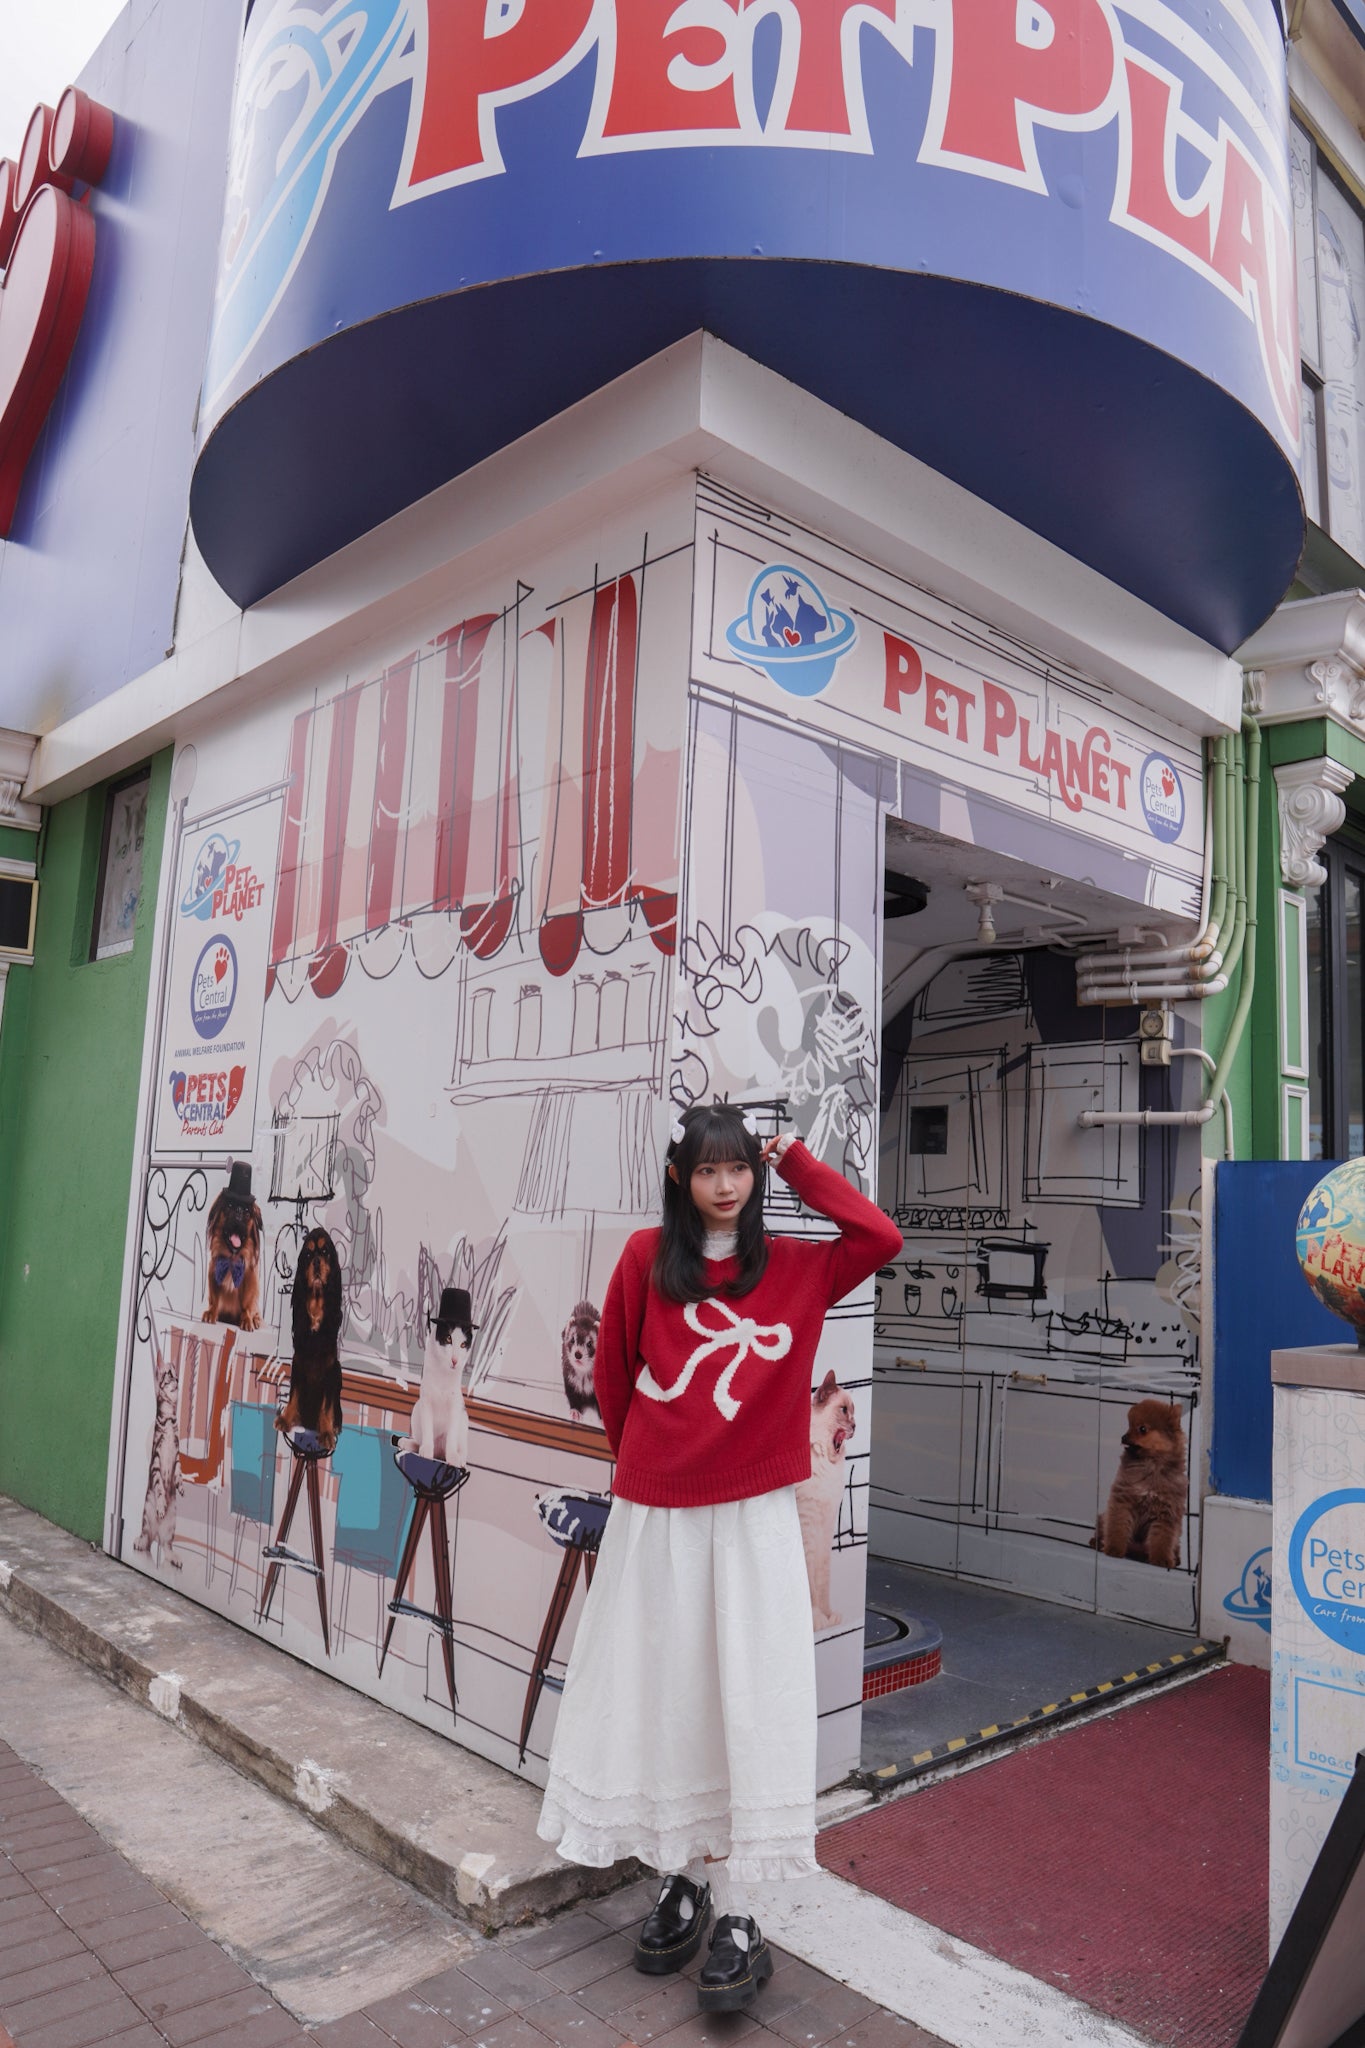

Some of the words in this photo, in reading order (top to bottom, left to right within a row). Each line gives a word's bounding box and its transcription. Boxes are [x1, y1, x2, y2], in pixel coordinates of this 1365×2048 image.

[883, 631, 976, 744] PET
[982, 679, 1131, 813] PLANET
[1145, 776, 1163, 797] Pets
[1149, 794, 1177, 819] Central
[225, 864, 252, 894] PET
[211, 874, 265, 922] PLANET
[196, 973, 214, 993] Pets
[199, 985, 228, 1009] Central
[174, 1049, 192, 1057] ANIMAL
[192, 1045, 213, 1056] WELFARE
[213, 1040, 246, 1053] FOUNDATION
[185, 1071, 228, 1104] PETS
[183, 1102, 226, 1122] CENTRAL
[181, 1119, 208, 1137] Parents
[208, 1119, 224, 1136] Club
[1307, 1238, 1365, 1289] PLAN
[1309, 1538, 1365, 1571] Pets
[1313, 1603, 1338, 1618] Care
